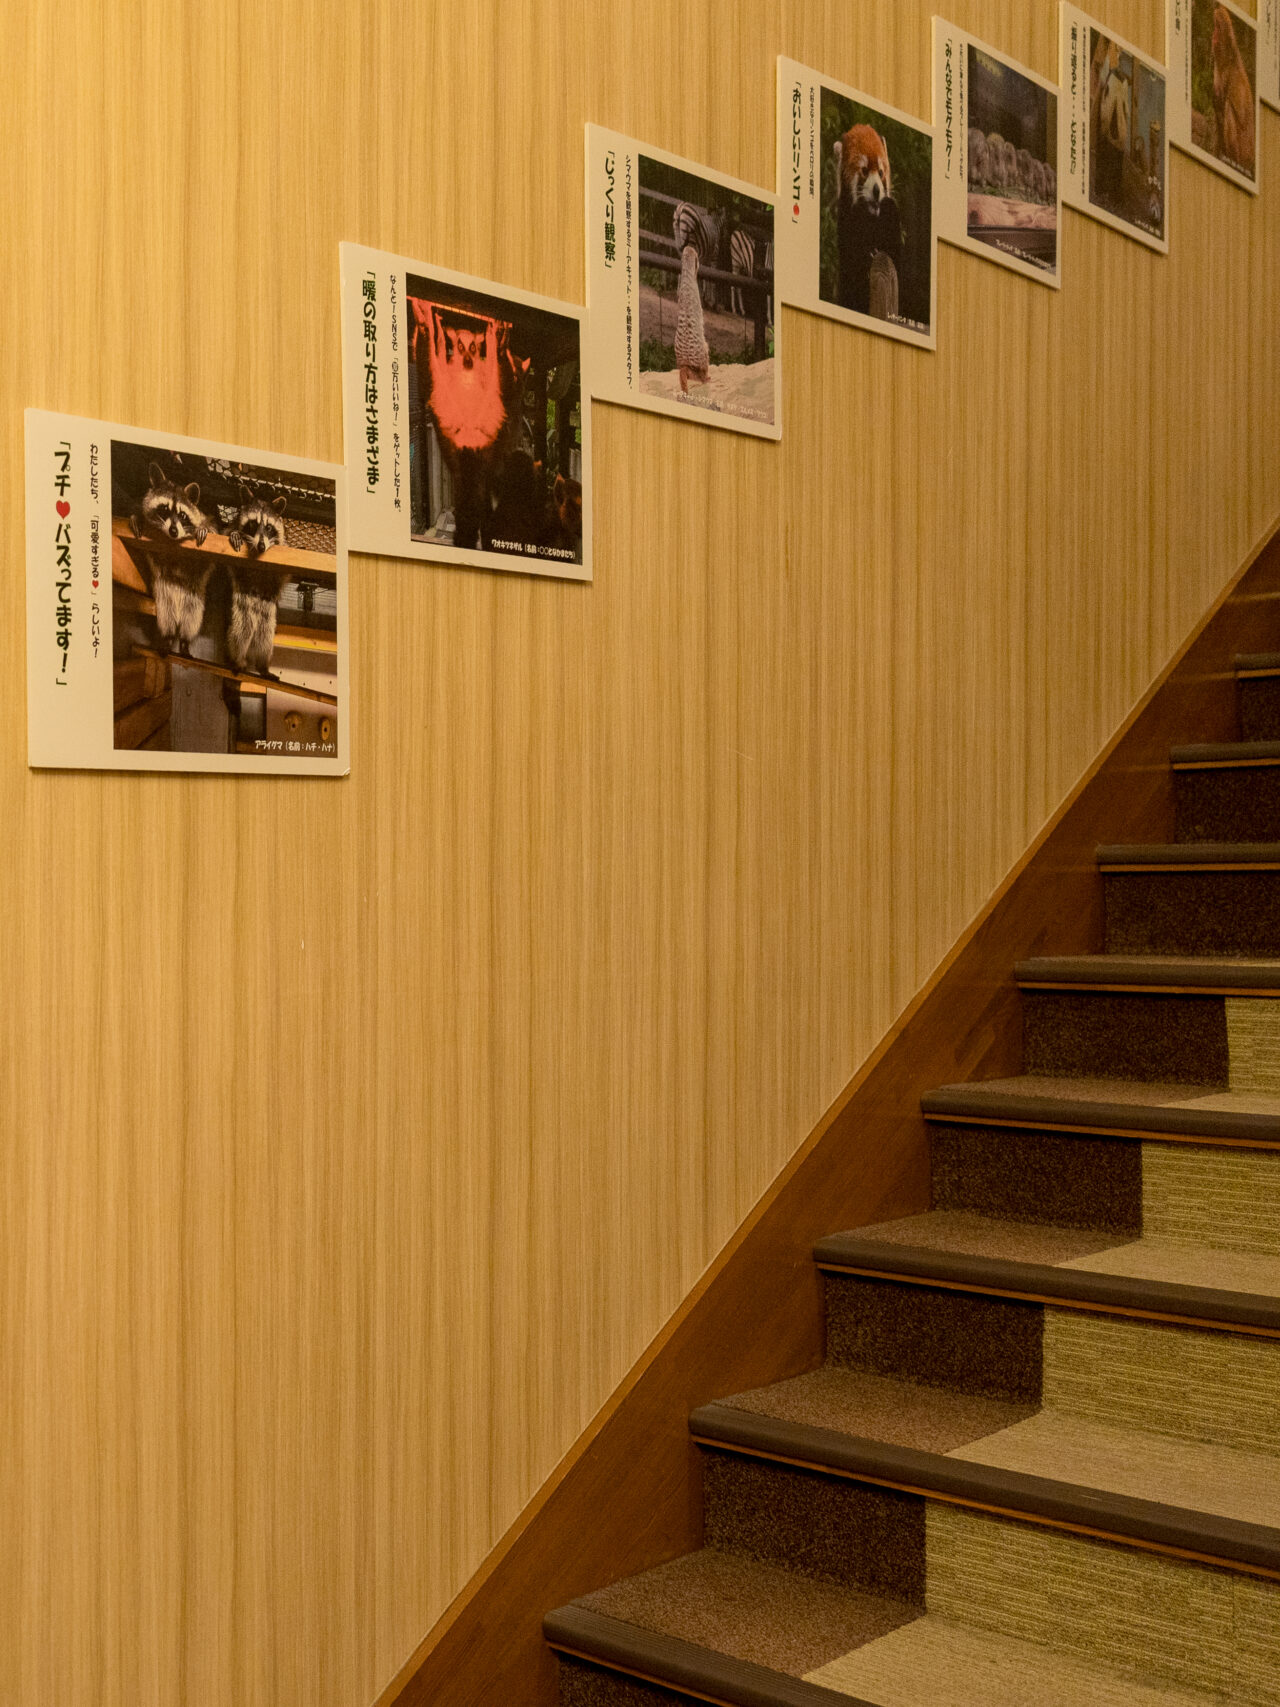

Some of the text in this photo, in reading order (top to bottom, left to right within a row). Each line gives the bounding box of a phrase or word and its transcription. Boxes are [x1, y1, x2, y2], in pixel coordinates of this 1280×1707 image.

[604, 150, 617, 269] 「じっくり観察」
[361, 270, 380, 495] 「暖の取り方はさまざま」
